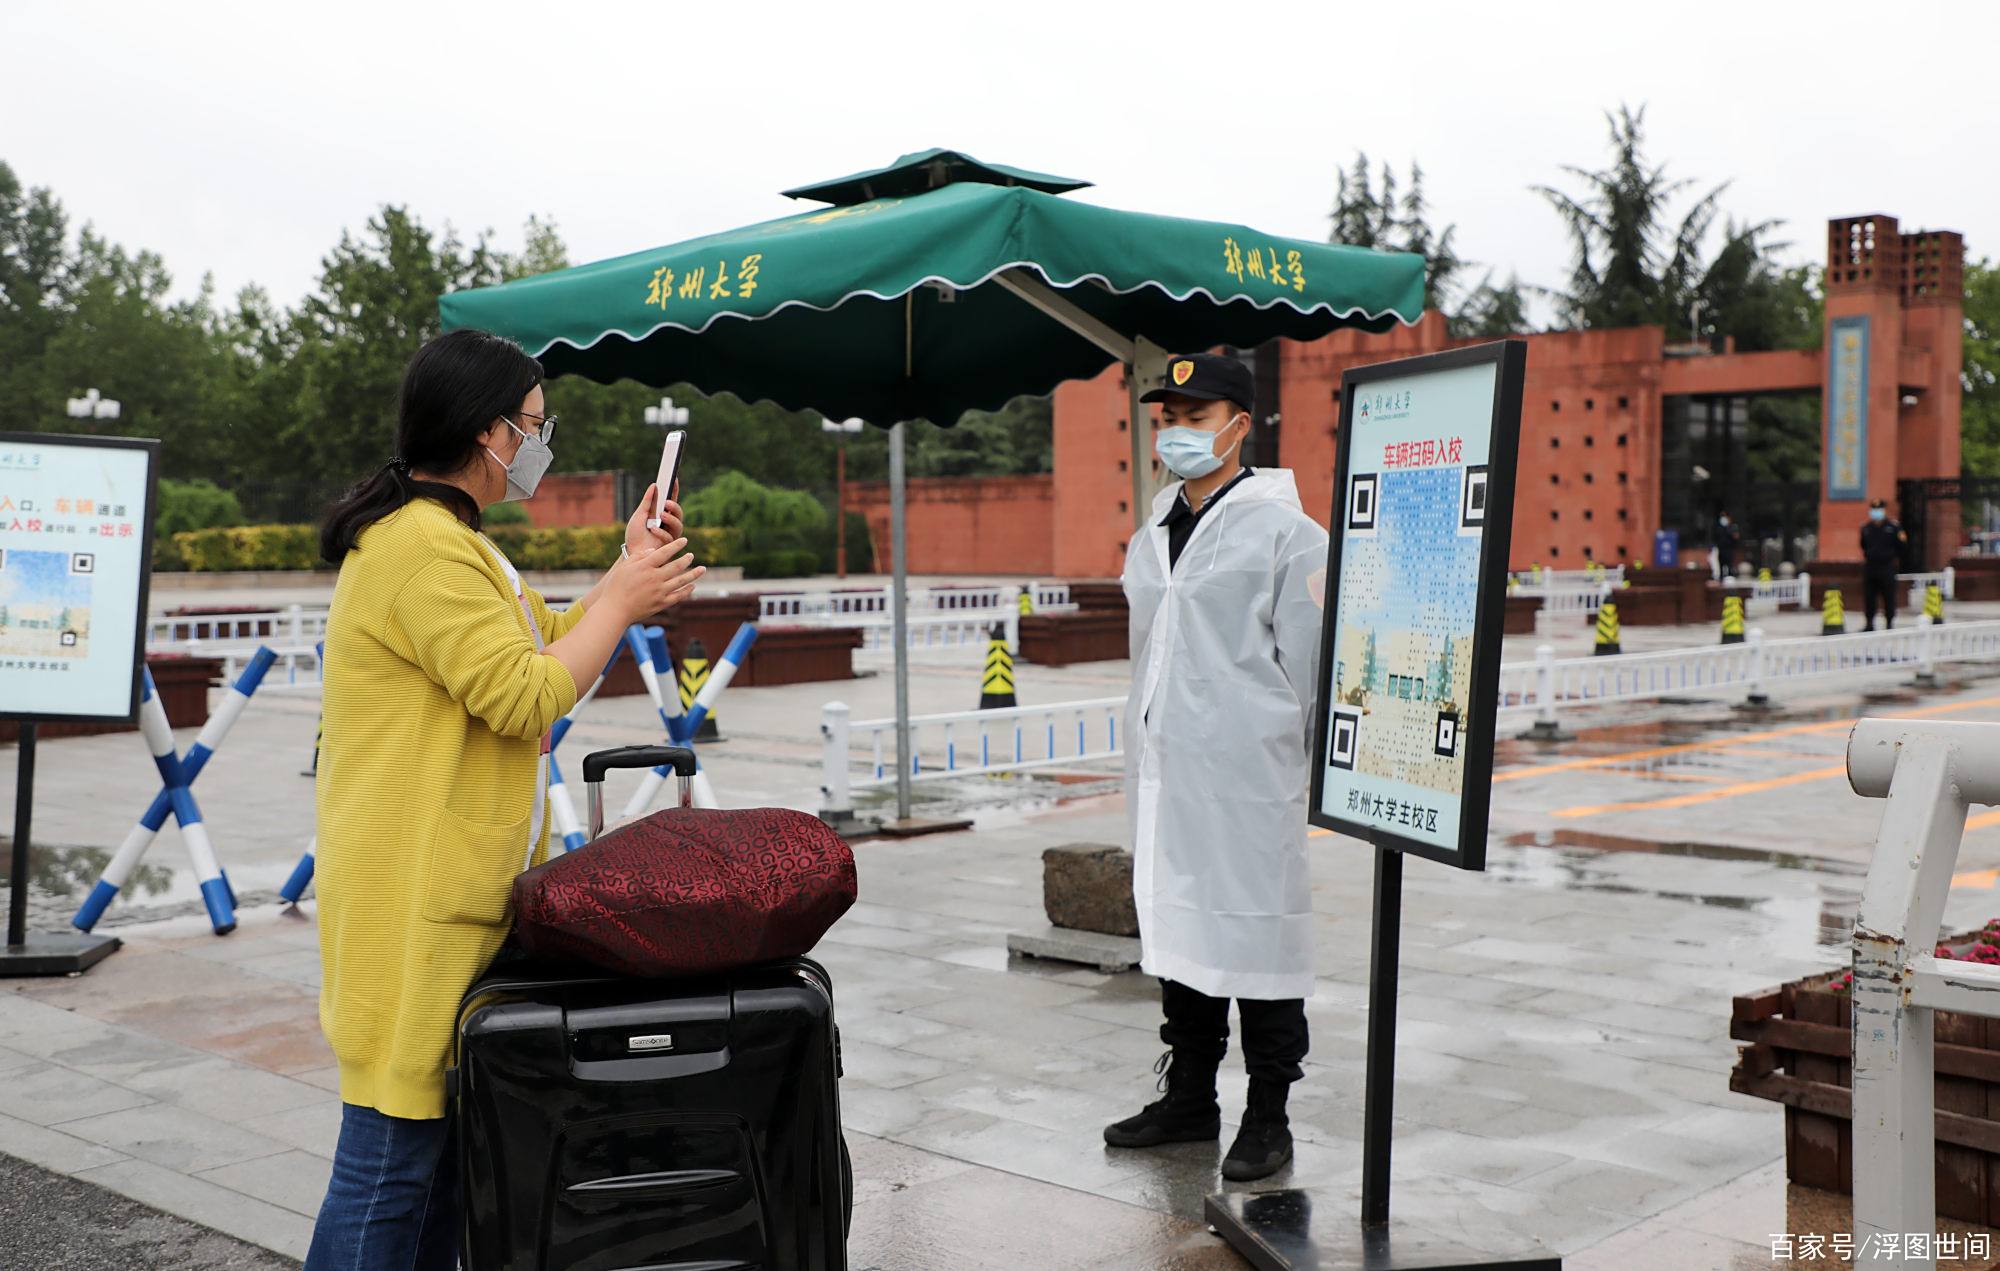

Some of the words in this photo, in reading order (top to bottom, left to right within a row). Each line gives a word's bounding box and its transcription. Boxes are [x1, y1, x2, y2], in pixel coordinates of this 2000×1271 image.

[645, 253, 763, 311] 郑州大学
[1224, 236, 1306, 292] 郑州大学
[1383, 436, 1463, 468] 车辆扫码入校
[1347, 788, 1439, 833] 郑州大学主校区
